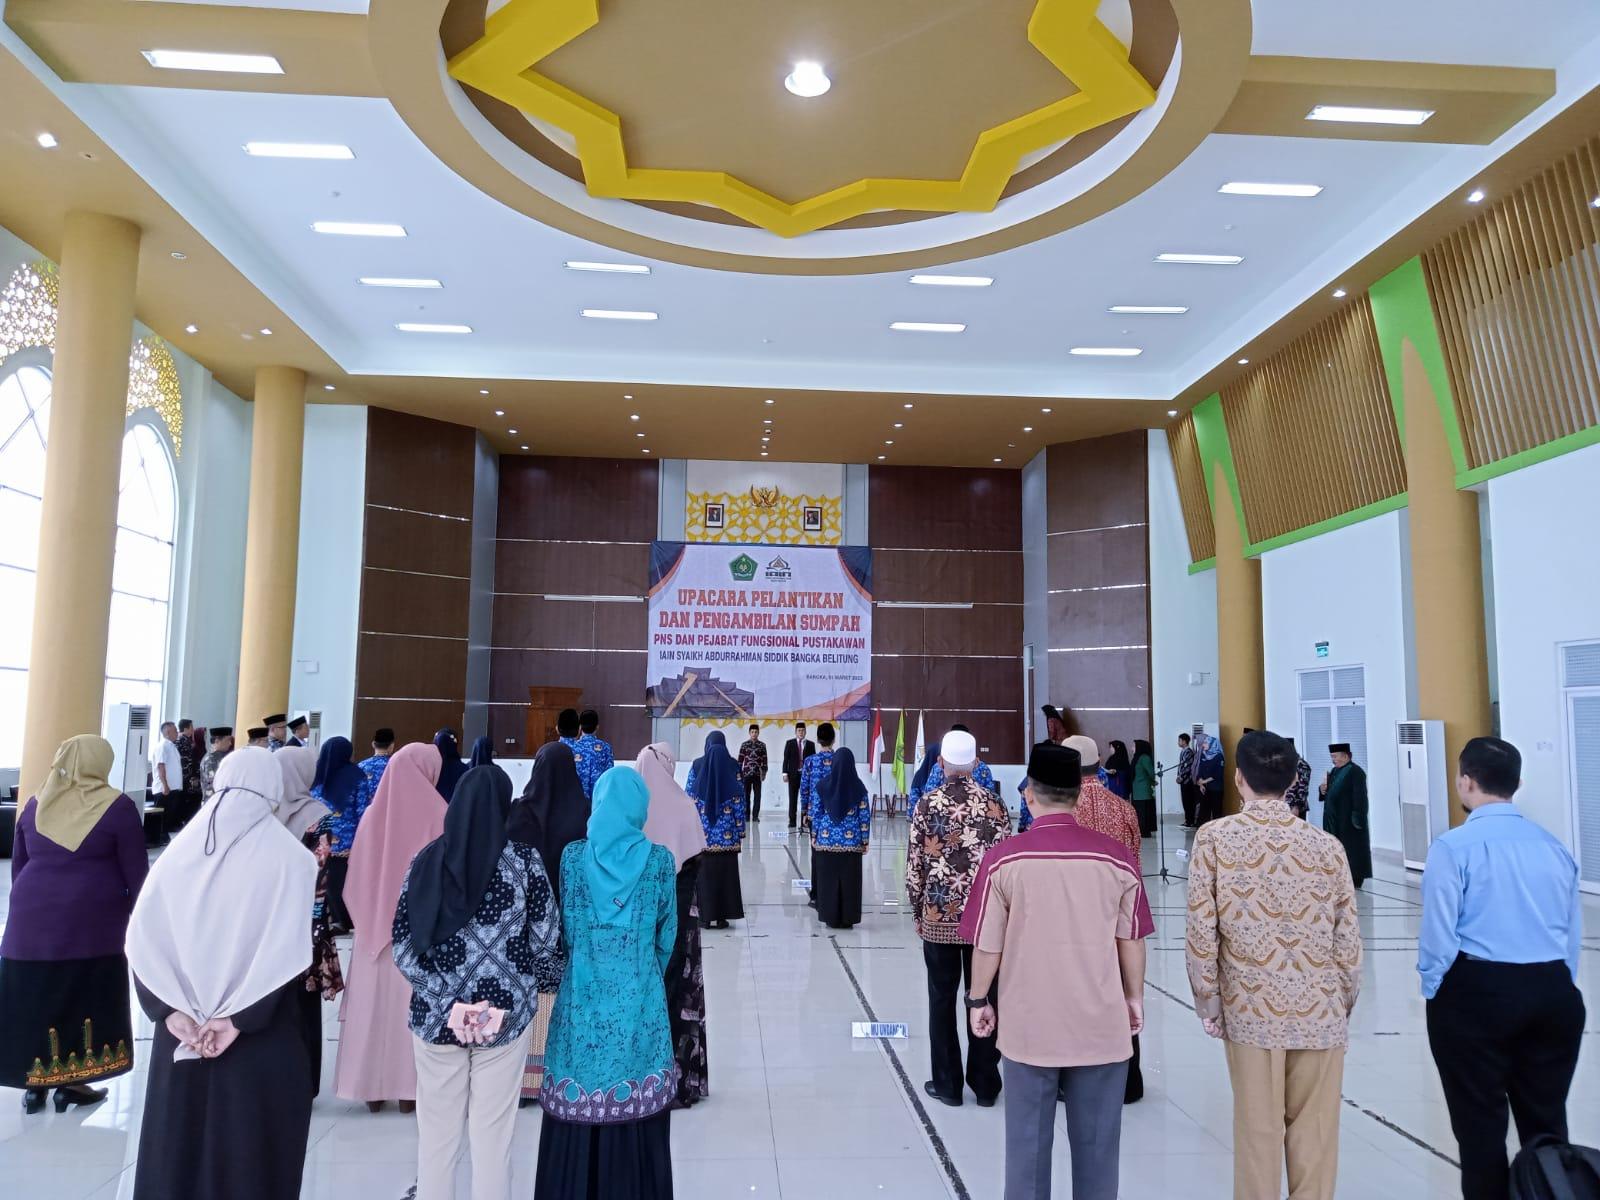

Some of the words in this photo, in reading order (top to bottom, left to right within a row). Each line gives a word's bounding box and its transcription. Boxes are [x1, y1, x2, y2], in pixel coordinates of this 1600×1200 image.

[678, 589, 748, 607] UPACARA
[751, 590, 843, 609] PELANTIKAN
[659, 611, 690, 628] DAN
[693, 611, 797, 630] PENGAMBILAN
[800, 614, 860, 632] SUMPAH
[654, 634, 673, 645] PNS
[675, 634, 695, 646] DAN
[697, 634, 739, 646] PEJABAT
[741, 635, 800, 647] FUNGSIONAL
[802, 636, 865, 649] PUSTAKAWAN
[660, 650, 675, 661] IAIN
[676, 651, 703, 661] SYAIKH
[705, 651, 762, 662] ABDURRAHMAN
[764, 652, 789, 663] SIDDIK
[790, 653, 821, 664] BANGKA
[822, 653, 859, 664] BELITUNG
